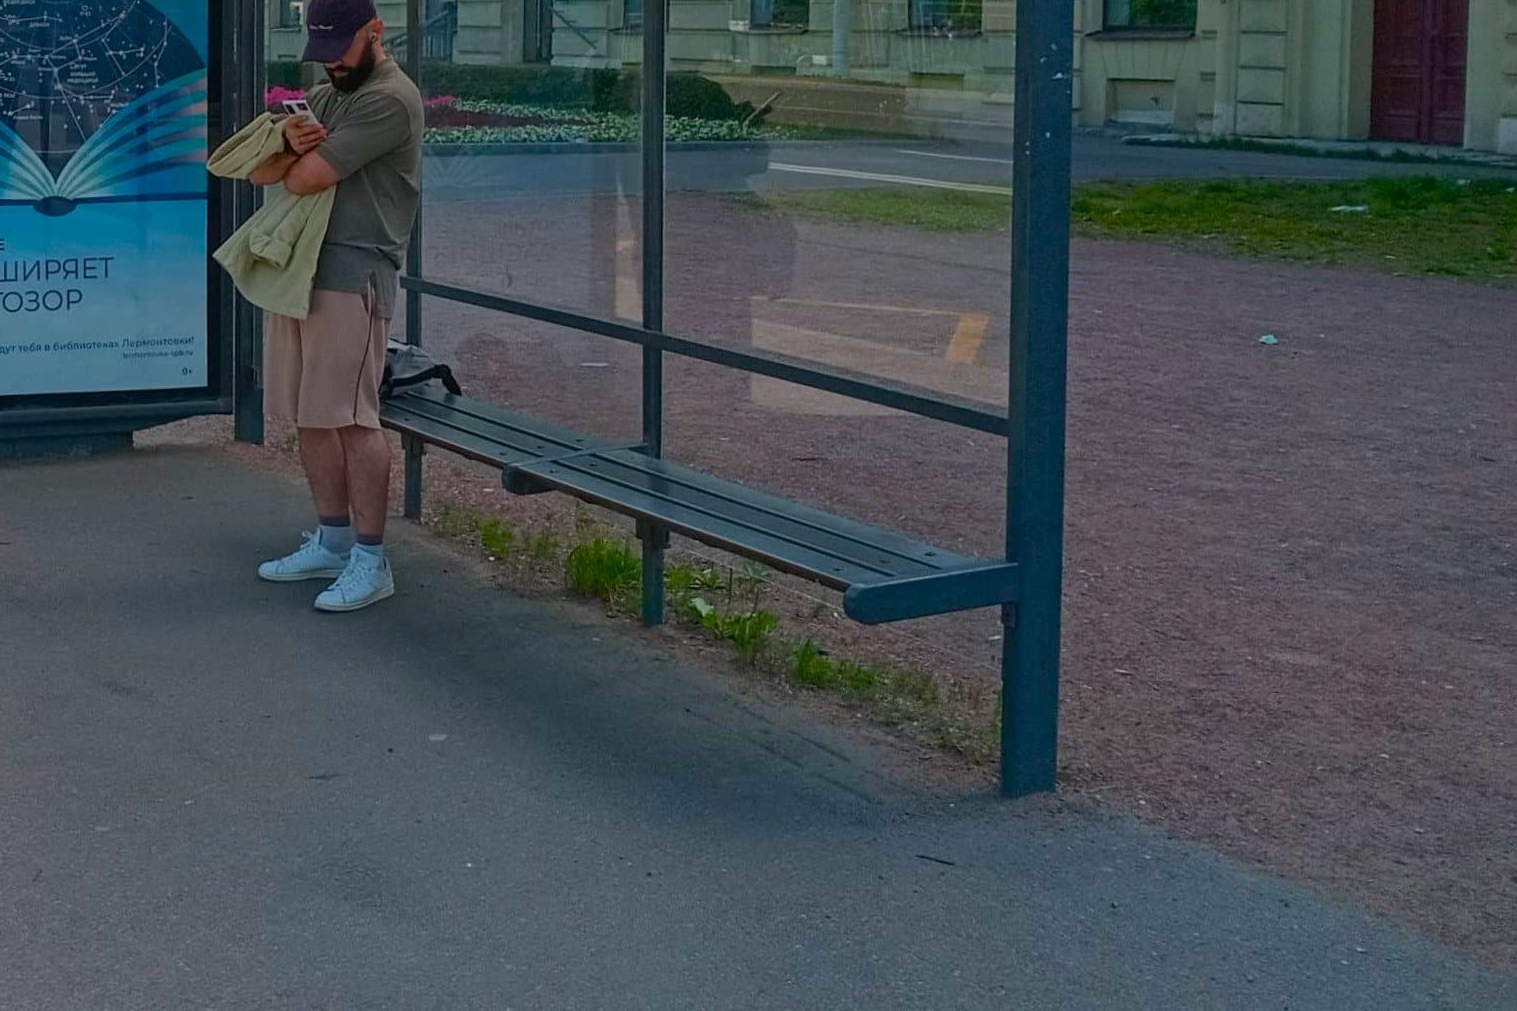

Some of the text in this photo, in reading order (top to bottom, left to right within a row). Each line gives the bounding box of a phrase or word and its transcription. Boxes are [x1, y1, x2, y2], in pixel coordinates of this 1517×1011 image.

[18, 342, 41, 353] тебя
[52, 340, 119, 351] библиотеках
[122, 335, 195, 349] Лермонтовки!
